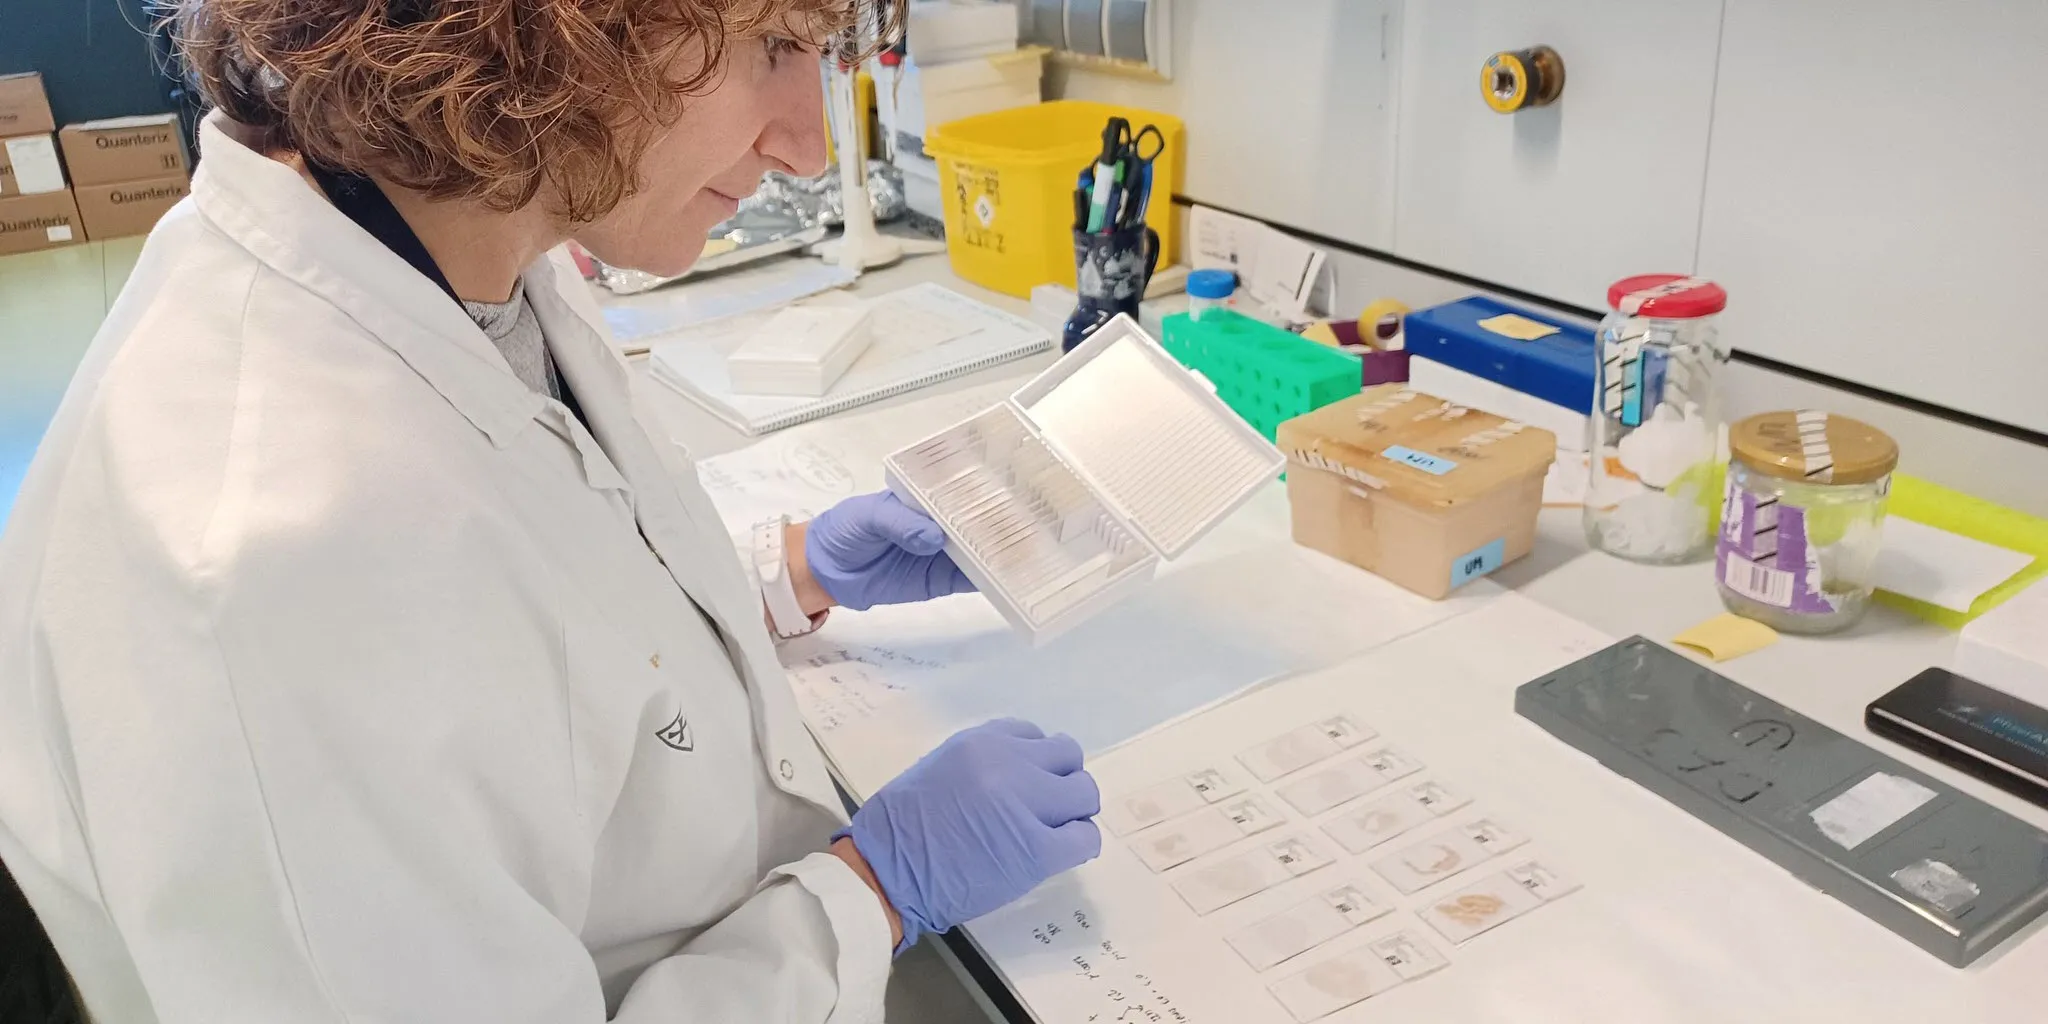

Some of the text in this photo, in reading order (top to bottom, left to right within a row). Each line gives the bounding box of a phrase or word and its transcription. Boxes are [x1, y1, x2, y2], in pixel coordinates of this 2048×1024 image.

[96, 132, 169, 149] Quanterix
[110, 185, 182, 204] Quanterix
[1464, 555, 1483, 575] UM
